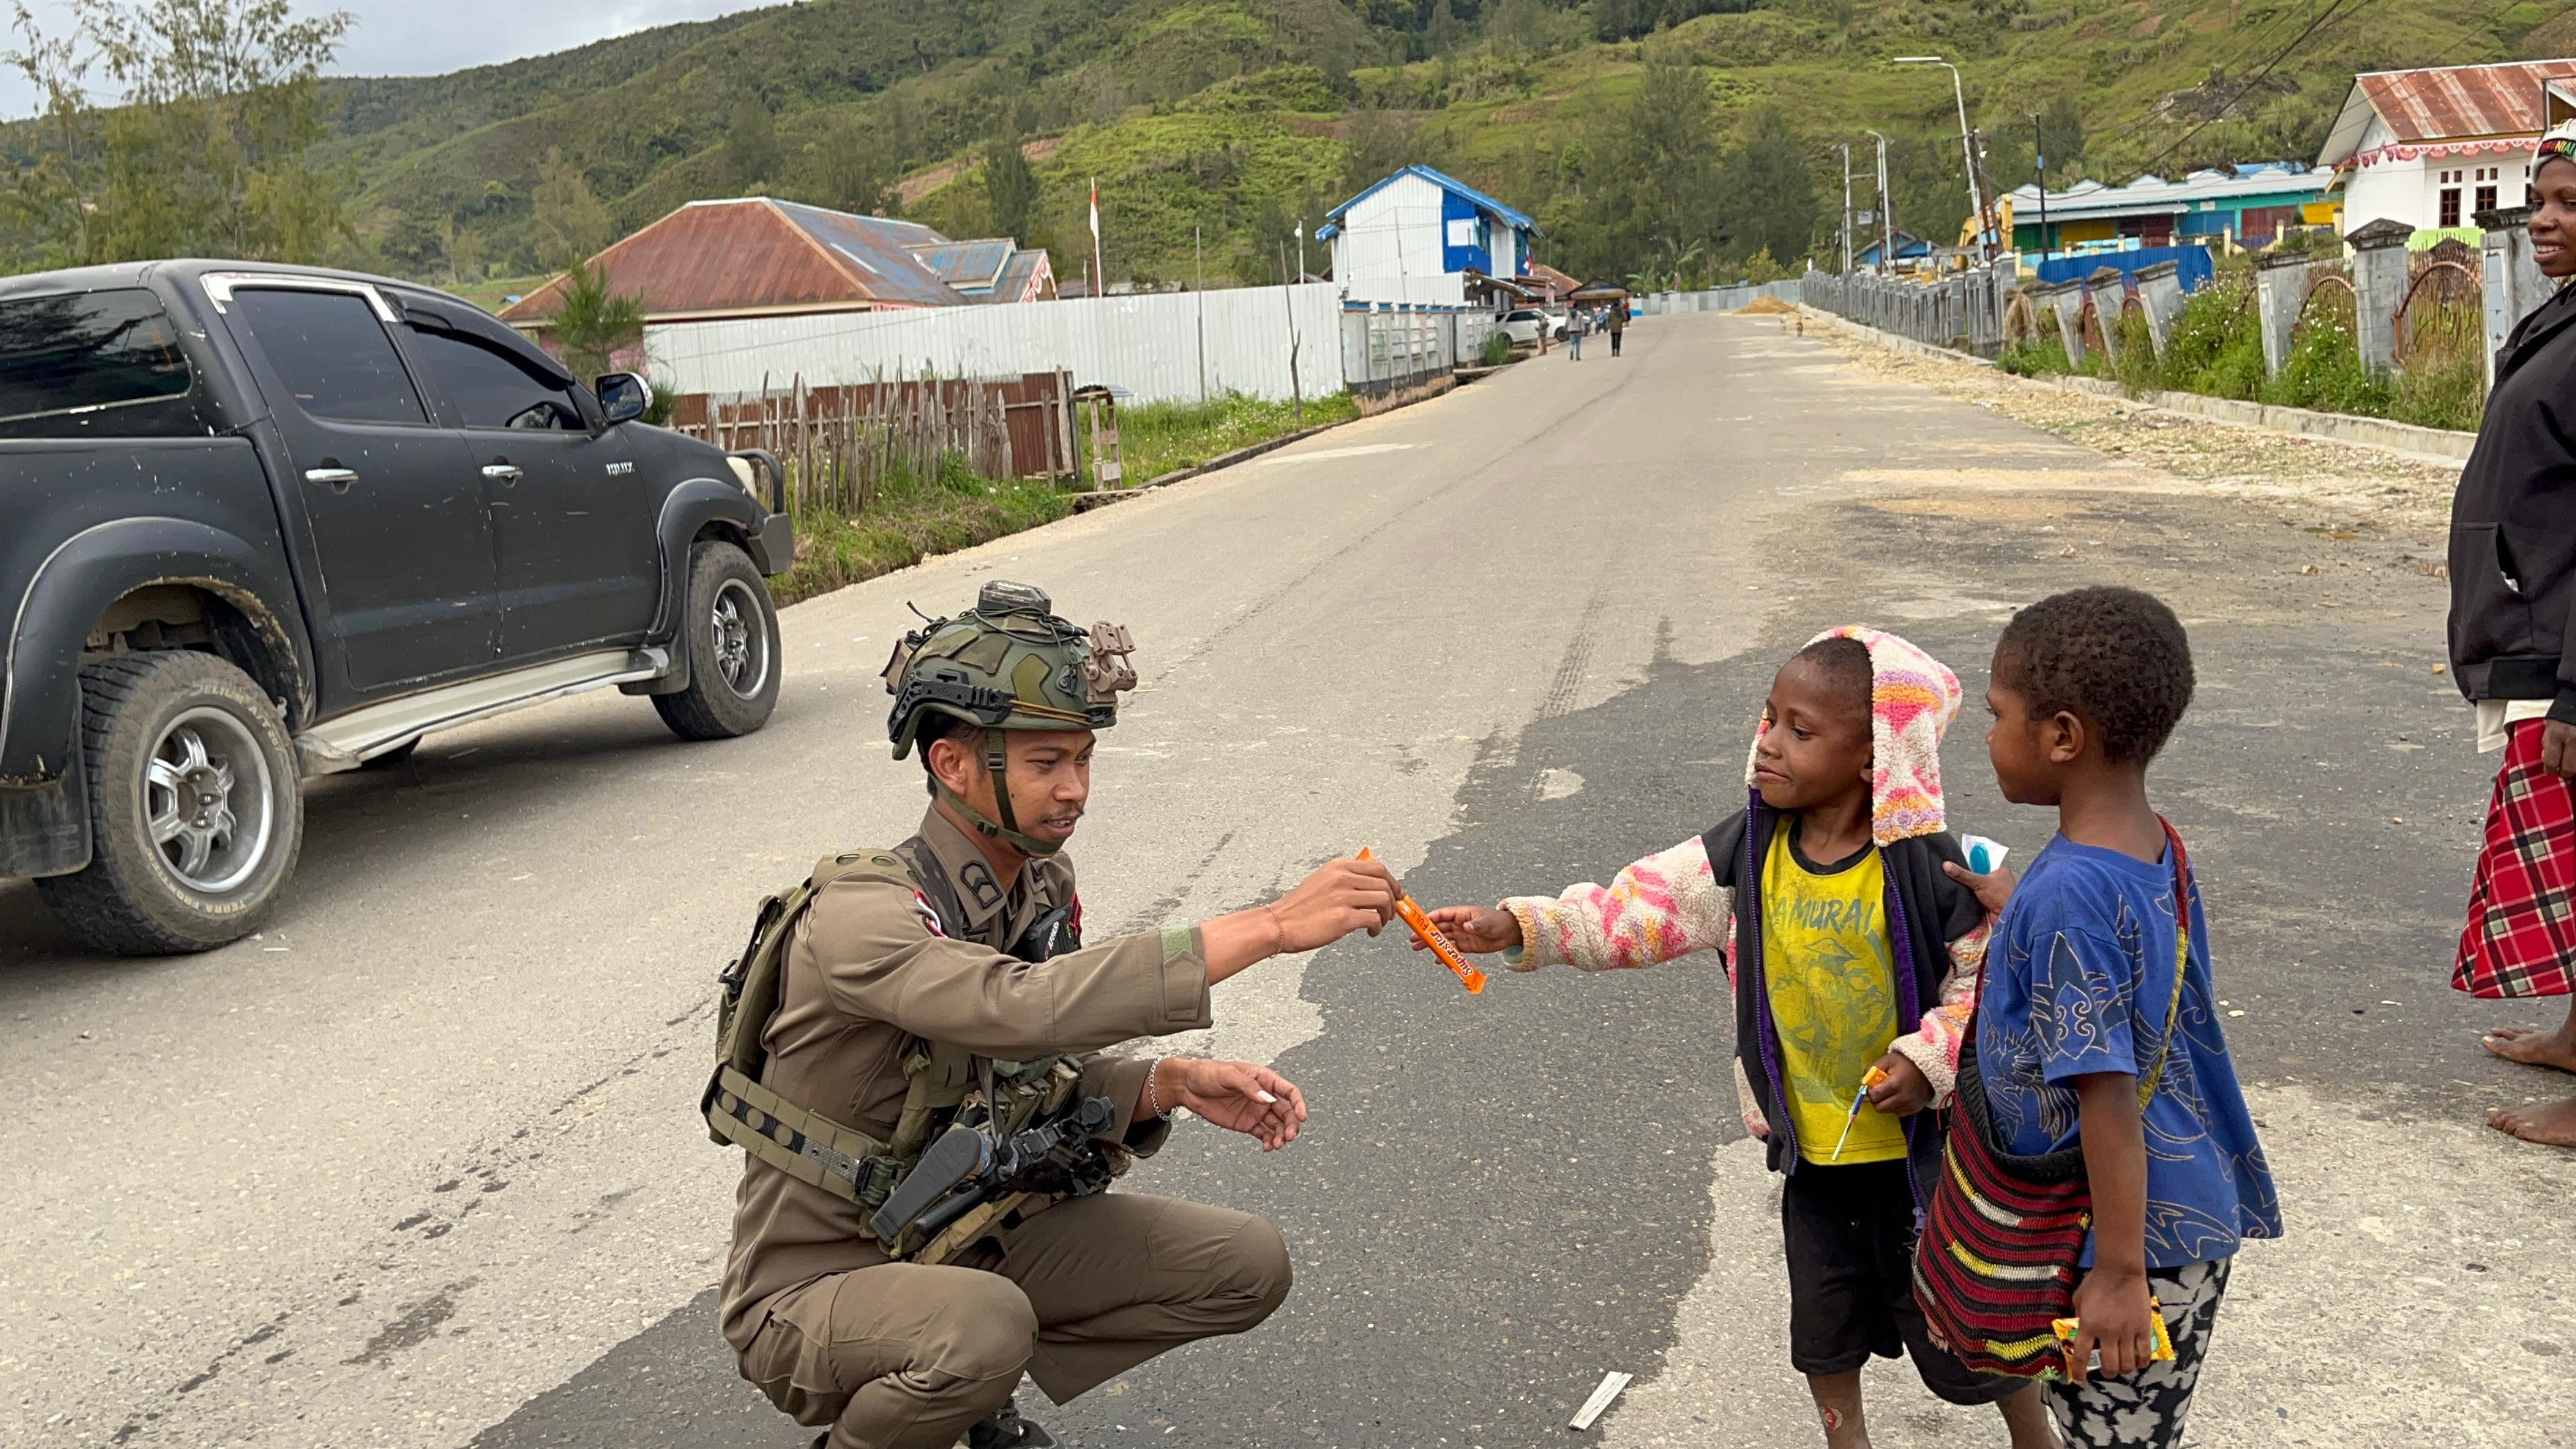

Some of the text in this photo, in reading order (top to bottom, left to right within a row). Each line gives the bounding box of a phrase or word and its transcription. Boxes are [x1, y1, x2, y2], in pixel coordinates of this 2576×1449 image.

[206, 899, 246, 914] TERRA
[1411, 907, 1474, 976] Superstar FULL
